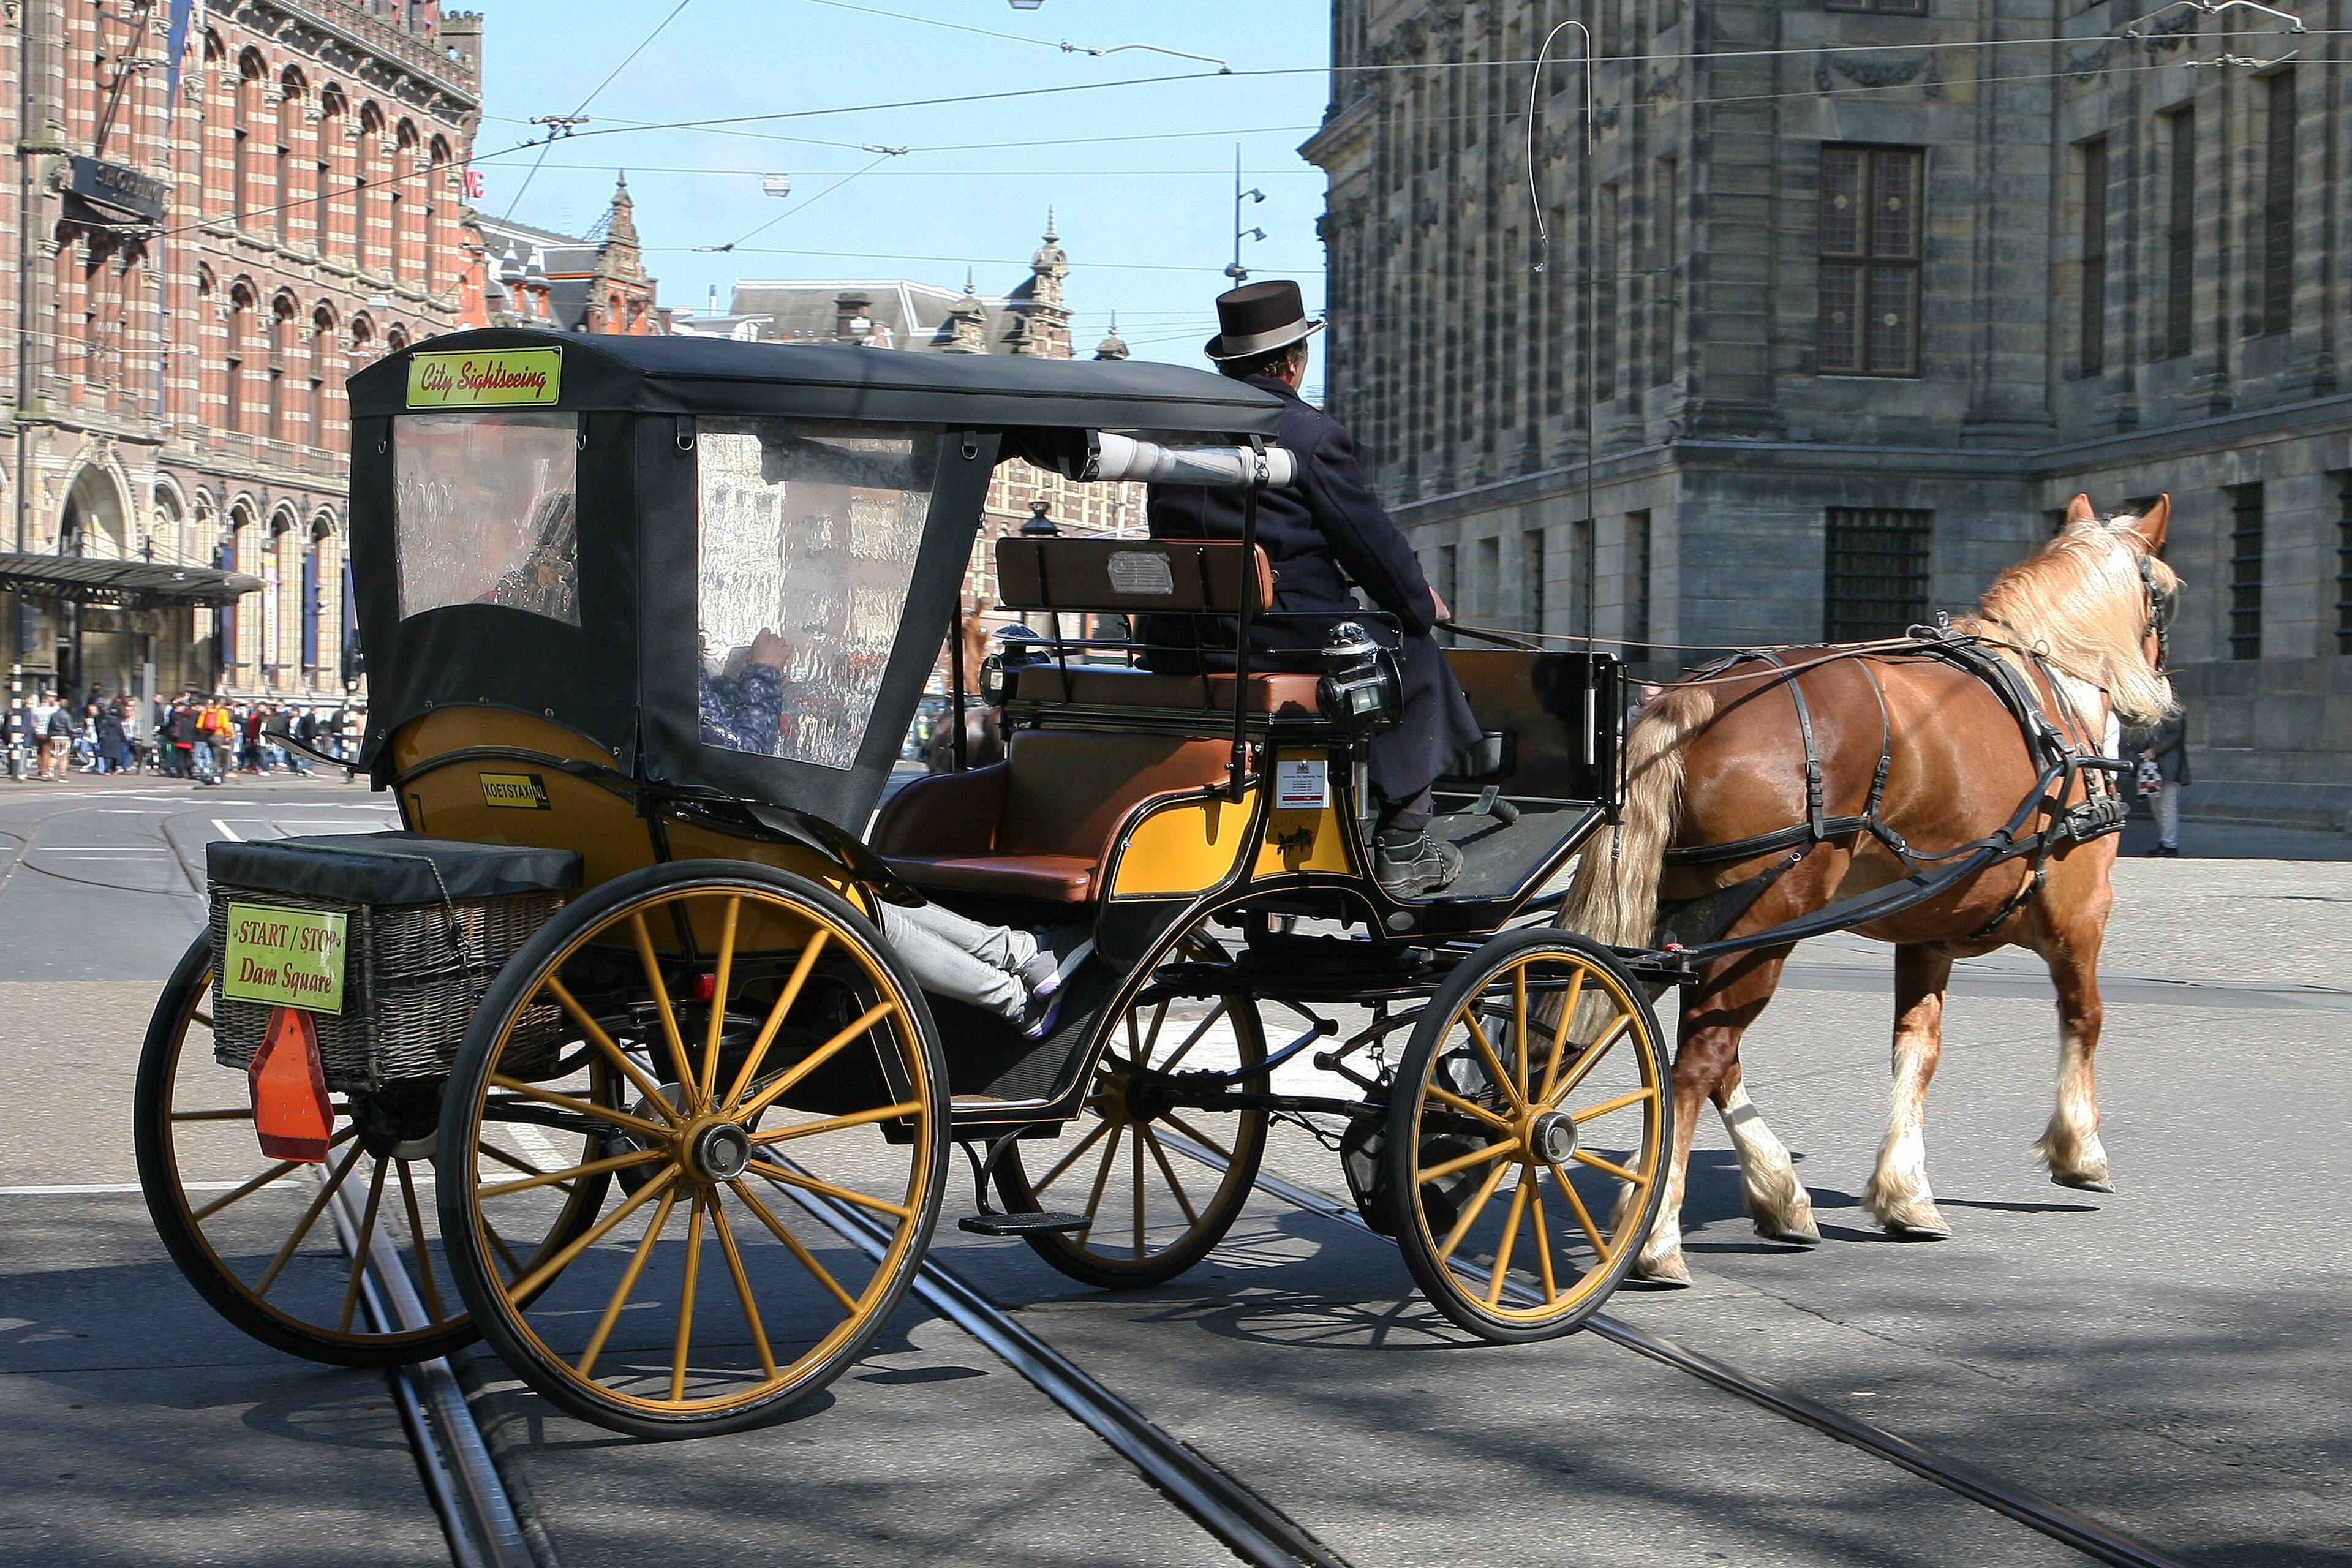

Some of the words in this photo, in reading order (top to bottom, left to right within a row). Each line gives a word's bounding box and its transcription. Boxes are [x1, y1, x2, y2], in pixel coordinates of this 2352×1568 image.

[421, 362, 452, 401] City
[457, 360, 546, 400] Sightseeing
[239, 921, 289, 948] START
[300, 927, 336, 954] STOP
[238, 957, 277, 986] Dam
[282, 962, 332, 997] Square
